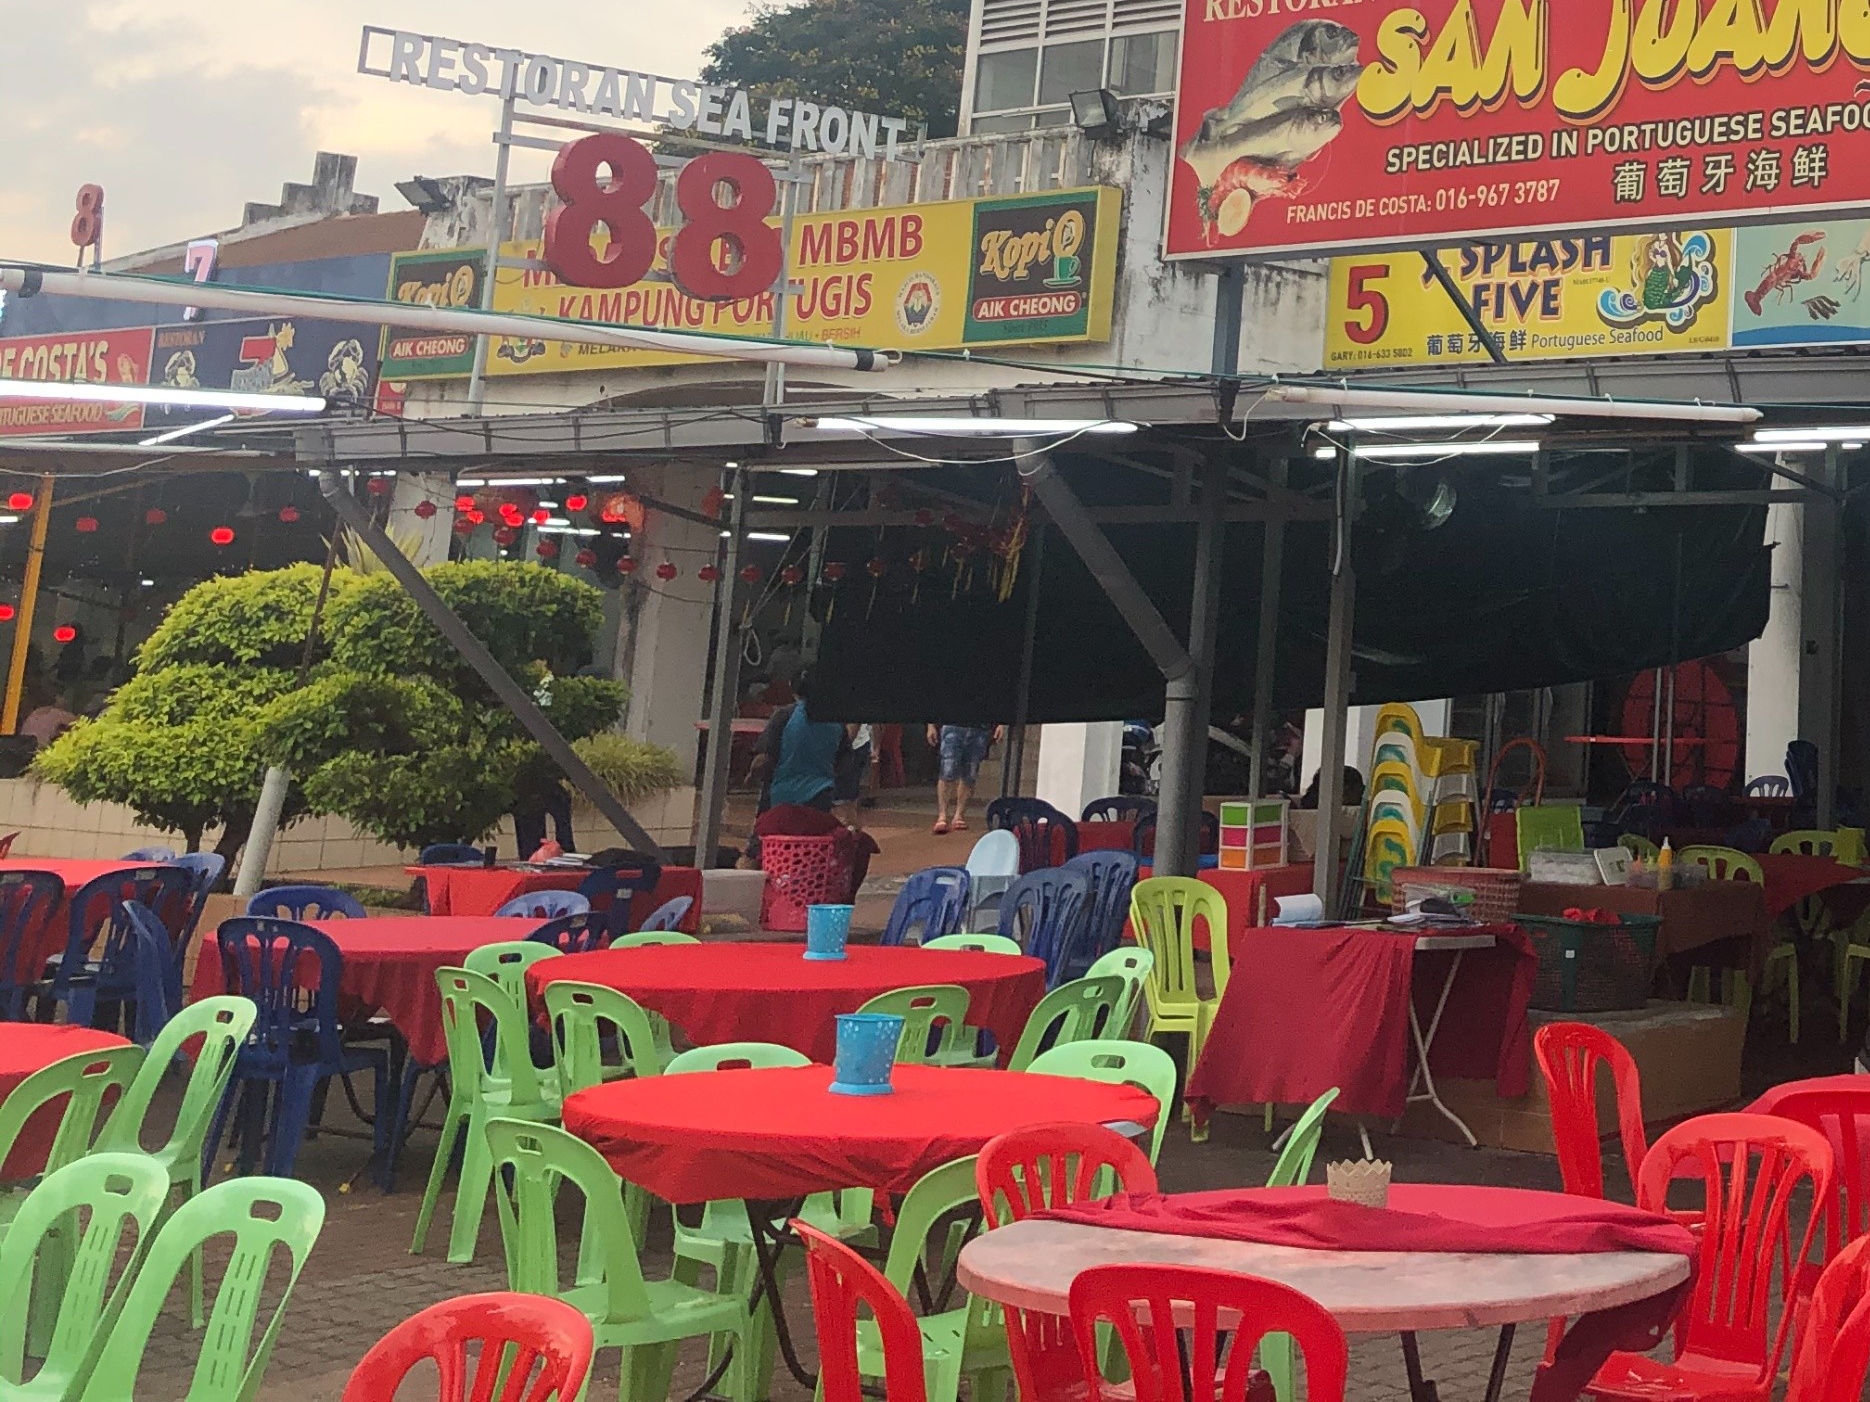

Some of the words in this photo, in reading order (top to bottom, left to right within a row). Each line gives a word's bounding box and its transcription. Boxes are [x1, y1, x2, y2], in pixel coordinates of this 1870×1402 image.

[388, 31, 657, 124] RESTORAN
[668, 79, 753, 141] SEA
[766, 98, 908, 163] FRONT
[1385, 132, 1544, 176] SPECIALIZED
[1551, 128, 1580, 159] IN
[1586, 112, 1764, 154] PORTUGUESE
[1286, 198, 1352, 224] FRANCIS
[1354, 198, 1377, 219] DE
[1378, 194, 1433, 217] COSTA:
[1435, 182, 1511, 212] 016-967
[1513, 178, 1561, 205] 3787
[1614, 145, 1830, 204] 葡萄牙海鲜
[71, 183, 105, 248] 8
[544, 133, 784, 300] 88
[798, 213, 924, 269] MBMB
[183, 237, 219, 321] 7
[557, 287, 706, 328] KAMPUNG
[711, 272, 874, 326] PORUGIS
[977, 300, 1005, 319] AIK
[1009, 295, 1077, 316] CHEONG
[1344, 264, 1391, 345] 5
[1472, 276, 1564, 325] FIVE
[392, 341, 413, 358] AIK
[416, 337, 467, 356] CHEONG
[1531, 332, 1606, 351] Portuguese
[1609, 326, 1665, 344] Seafood
